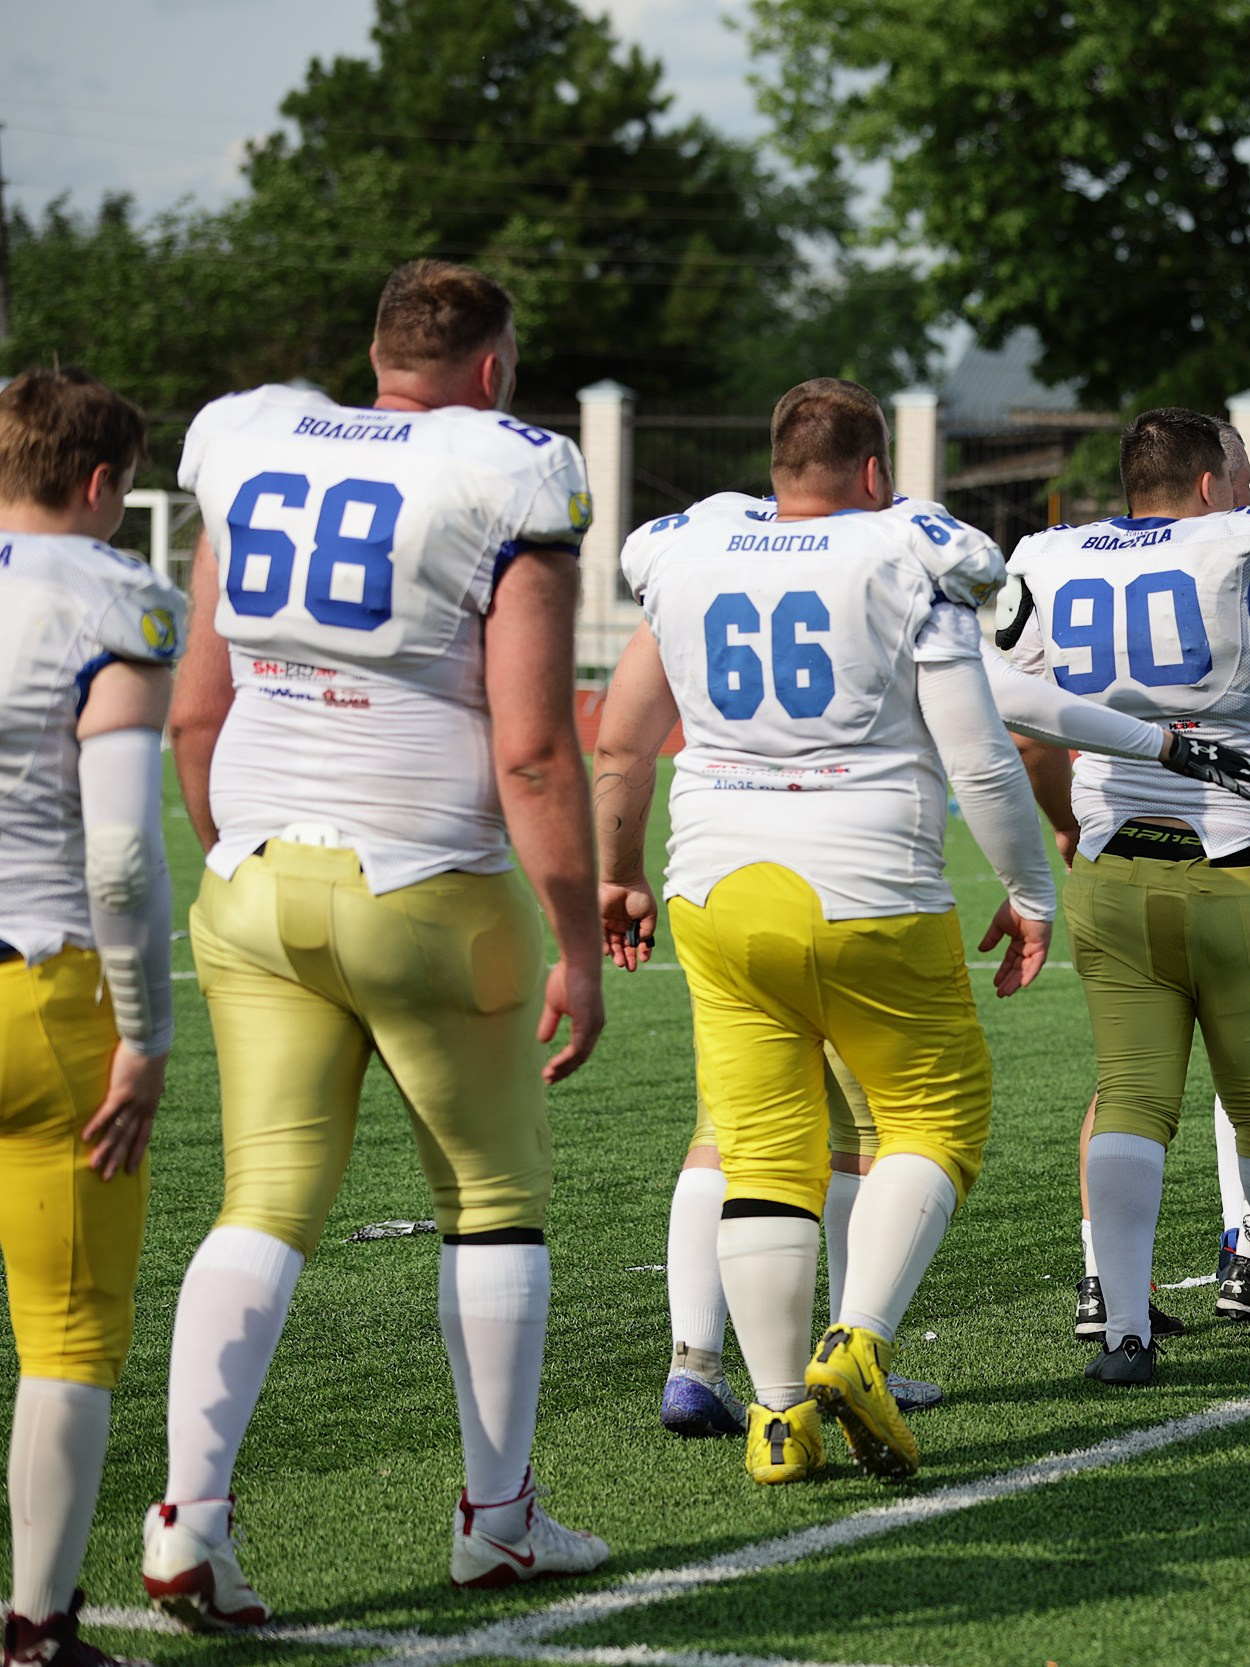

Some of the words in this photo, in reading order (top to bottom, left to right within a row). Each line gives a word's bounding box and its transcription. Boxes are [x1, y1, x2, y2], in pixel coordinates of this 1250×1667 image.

[293, 416, 412, 442] ВОЛОГДА
[226, 470, 404, 631] 68
[727, 535, 829, 552] ВОЛОГДА
[1081, 528, 1172, 551] ВОЛОГДА
[704, 590, 836, 720] 66
[1051, 569, 1213, 695] 90
